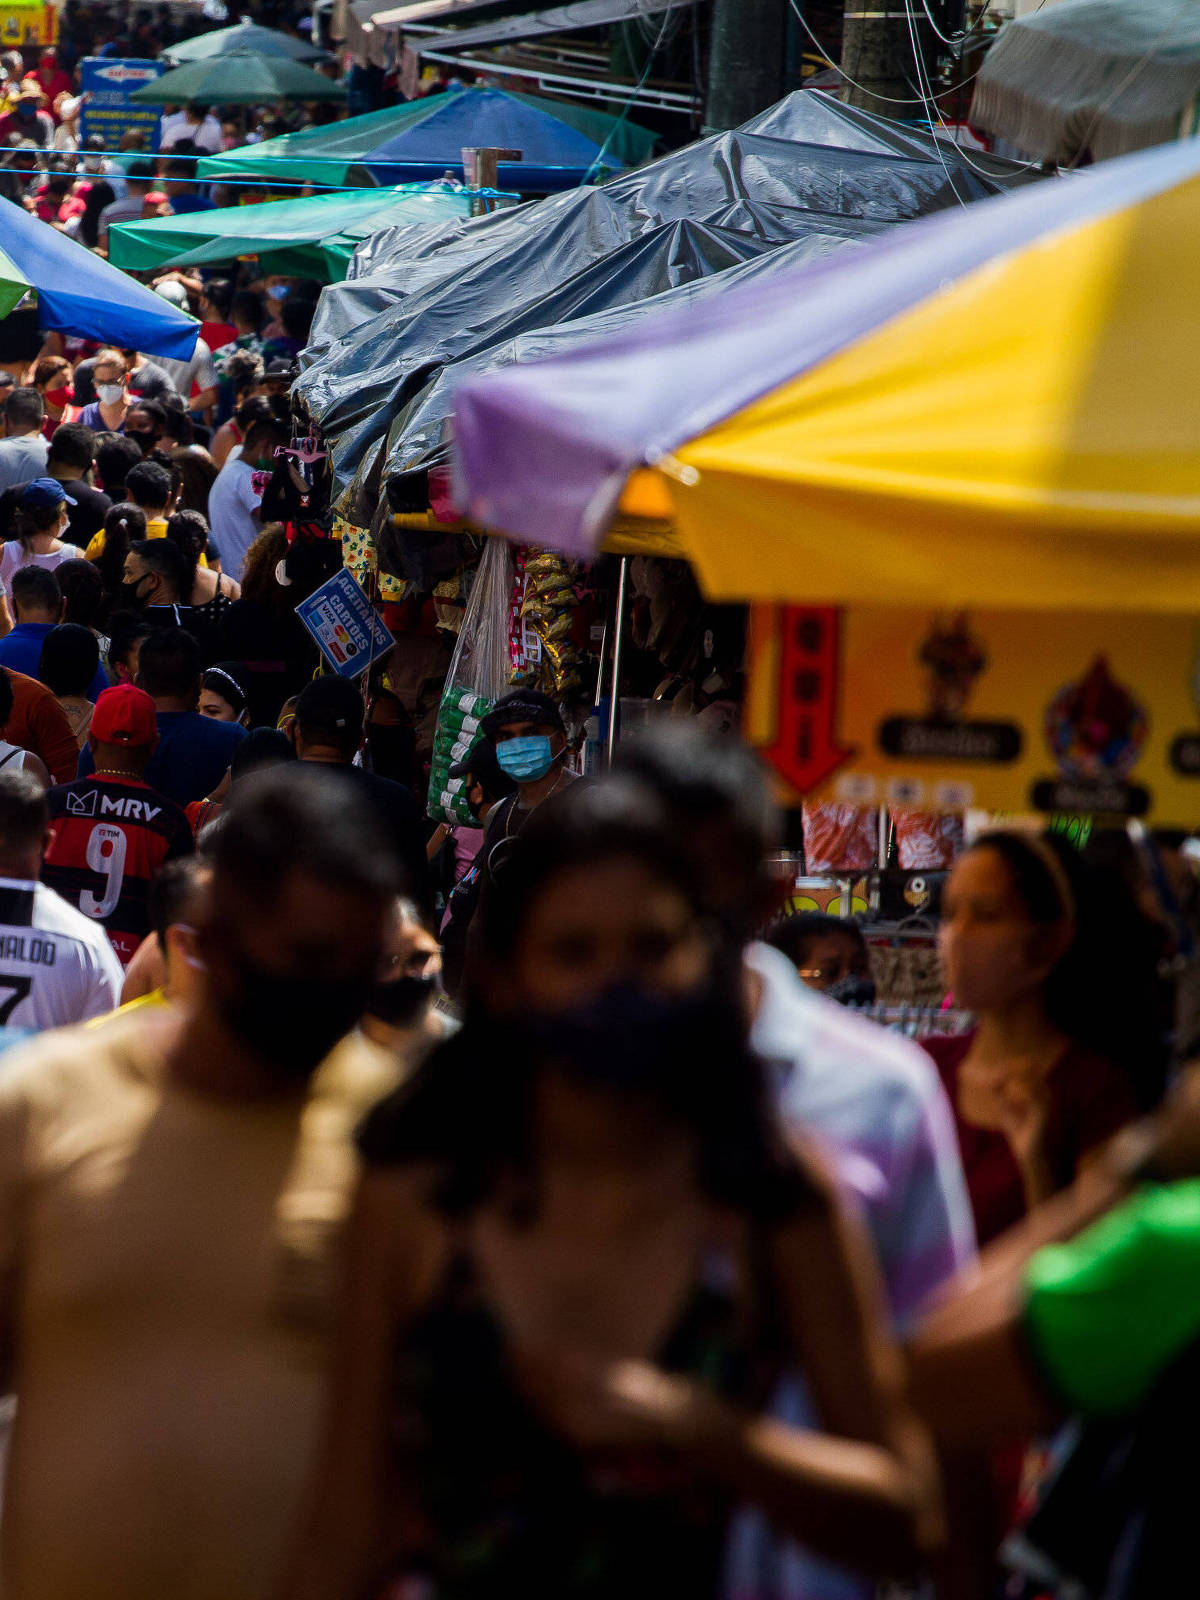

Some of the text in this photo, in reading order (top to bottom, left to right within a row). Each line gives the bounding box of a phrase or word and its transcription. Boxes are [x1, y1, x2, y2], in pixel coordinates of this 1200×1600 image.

[337, 576, 387, 646] ACEITAMOS
[101, 795, 162, 822] MRV
[79, 823, 127, 919] 9
[111, 939, 131, 952] AL
